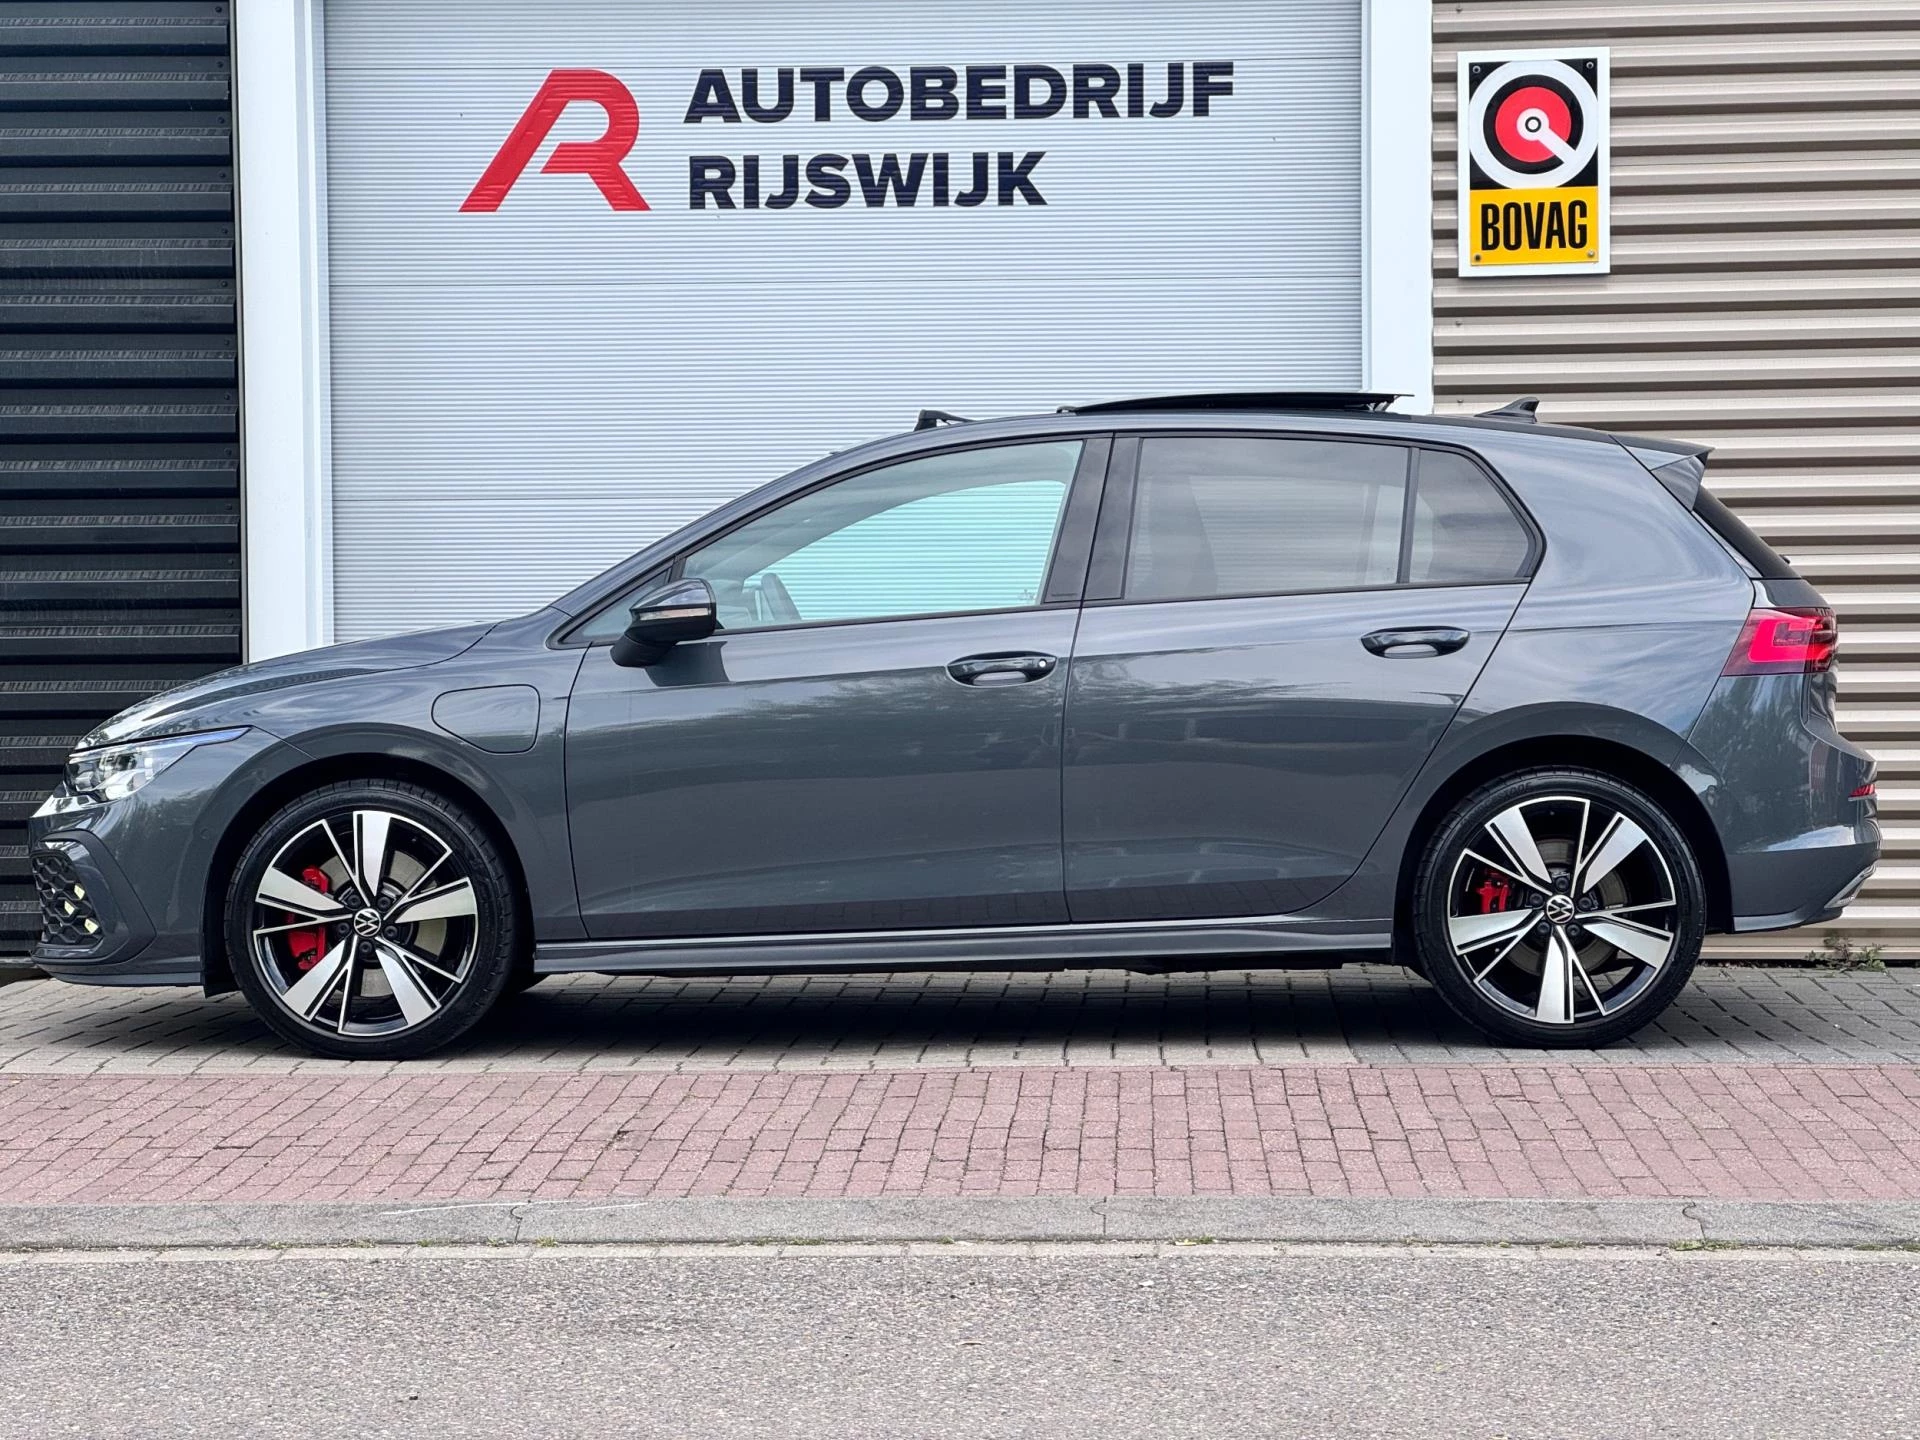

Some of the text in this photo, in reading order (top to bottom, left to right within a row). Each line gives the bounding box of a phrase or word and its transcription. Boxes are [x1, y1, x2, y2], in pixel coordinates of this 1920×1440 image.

[684, 61, 1234, 124] AUTOBEDRIJF
[689, 151, 1047, 210] RIJSWIJK
[1481, 199, 1588, 251] BOVAG
